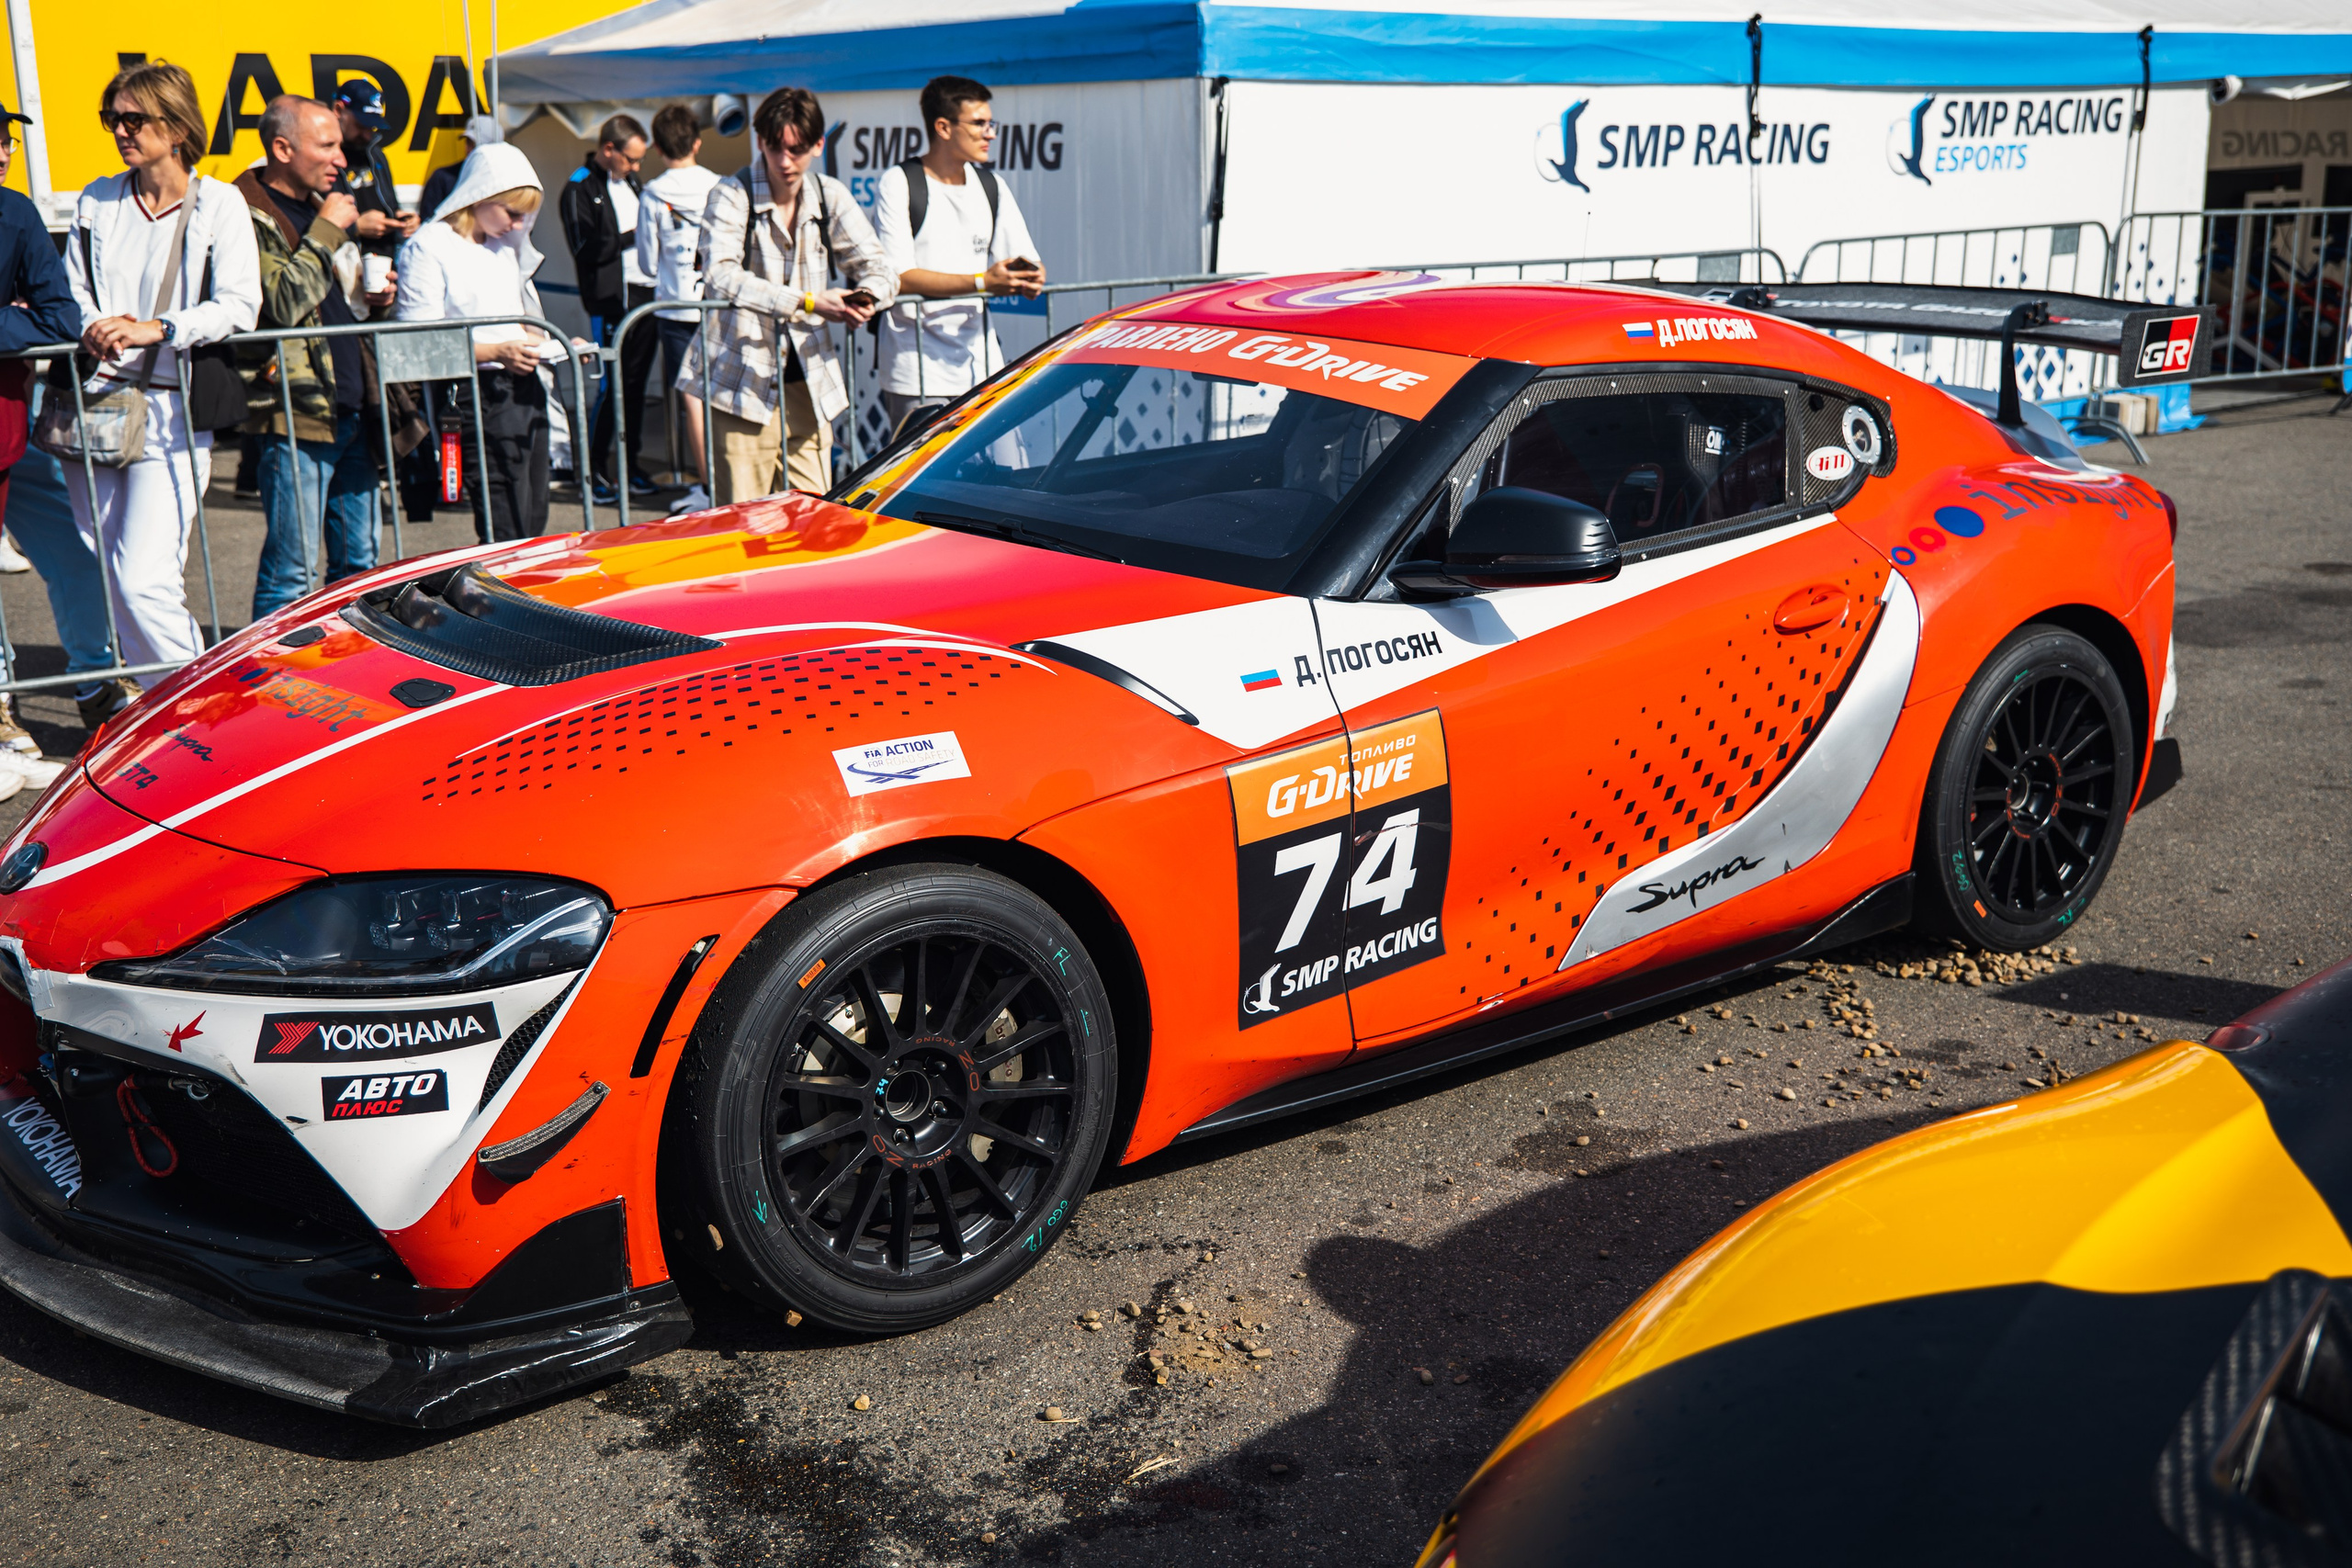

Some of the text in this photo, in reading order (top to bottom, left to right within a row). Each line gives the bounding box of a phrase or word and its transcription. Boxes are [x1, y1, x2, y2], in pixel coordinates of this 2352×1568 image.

[118, 51, 491, 155] ADA
[1941, 96, 2124, 139] SMP RACING
[853, 126, 923, 171] SMP
[1597, 122, 1830, 170] SMP RACING
[1935, 143, 2029, 173] ESPORTS
[2140, 338, 2191, 371] GR
[1326, 630, 1443, 675] ПОГОСЯН
[248, 667, 368, 733] insight
[163, 723, 214, 763] Supra
[867, 748, 956, 768] FOR ROAD SAFETY
[885, 739, 934, 757] ACTION
[1339, 734, 1417, 766] ТОПЛИВО
[116, 761, 160, 791] GT4
[1273, 807, 1421, 954] 74
[1624, 855, 1766, 914] Supra
[1280, 916, 1438, 998] SMP RACING
[318, 1014, 486, 1052] YOKOHAMA
[914, 1035, 956, 1048] RACING
[336, 1072, 438, 1102] АВТО
[331, 1099, 404, 1118] ПЛЮС
[2, 1096, 83, 1200] YOKOHAMA
[911, 1148, 953, 1169] RACING
